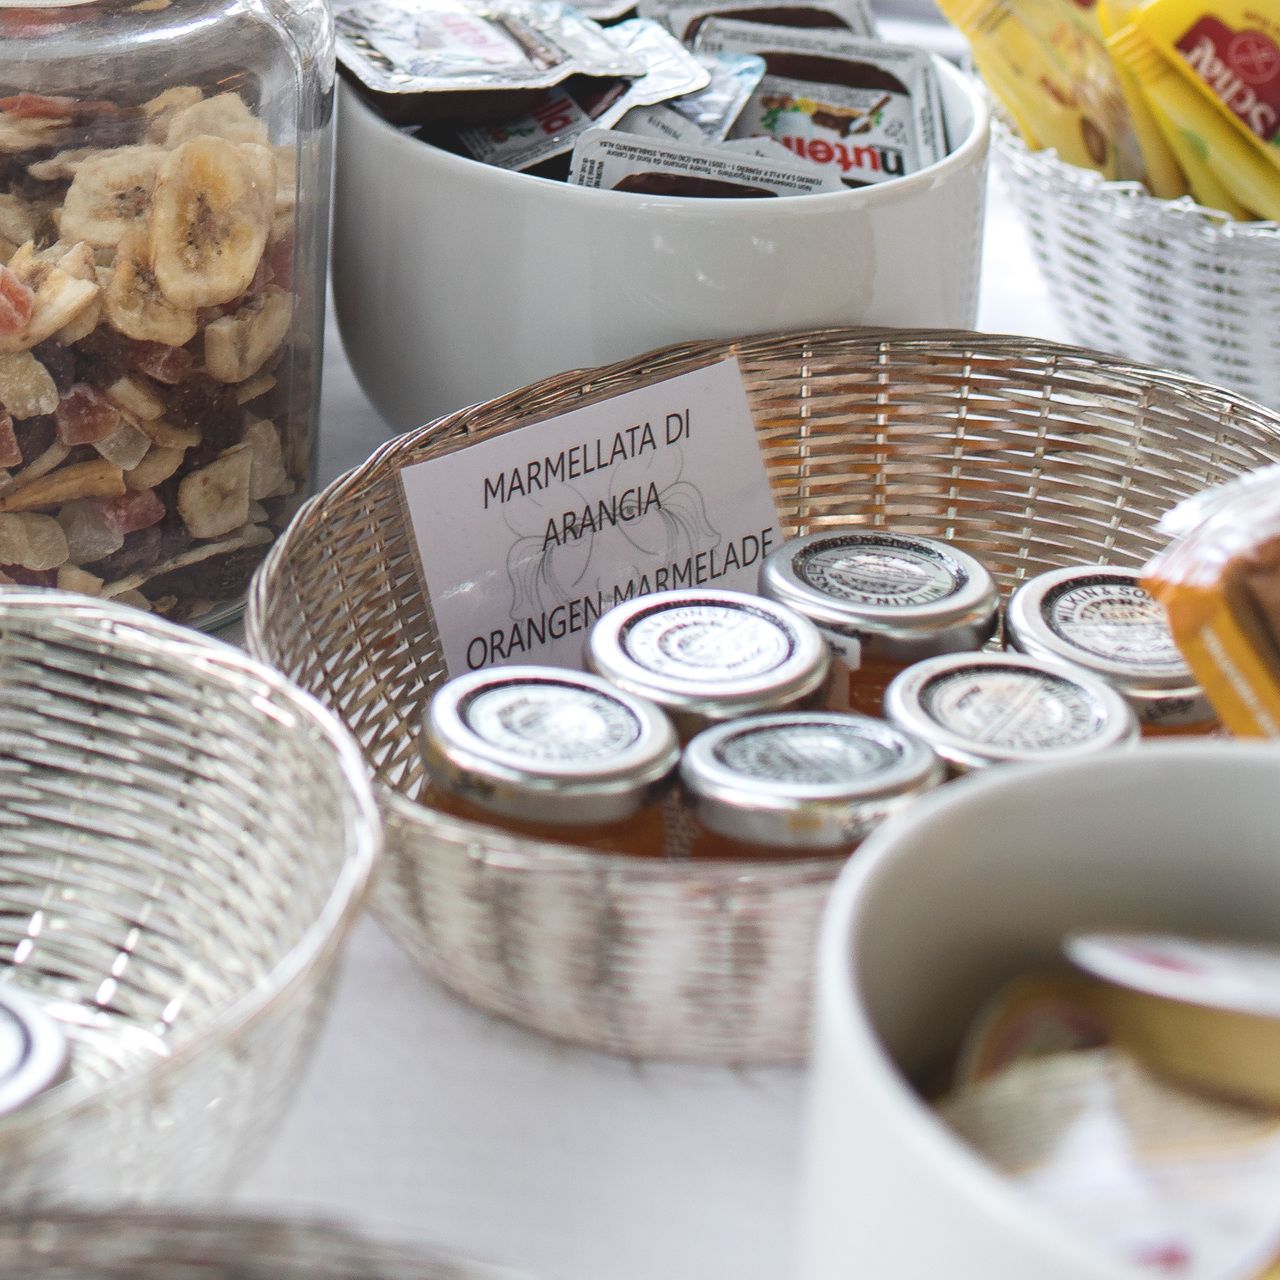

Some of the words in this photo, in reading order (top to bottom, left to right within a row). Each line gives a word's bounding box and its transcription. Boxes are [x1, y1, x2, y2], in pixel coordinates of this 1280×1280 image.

[483, 422, 657, 509] MARMELLATA
[666, 409, 691, 446] DI
[542, 481, 662, 551] ARANCIA
[466, 591, 603, 670] ORANGEN
